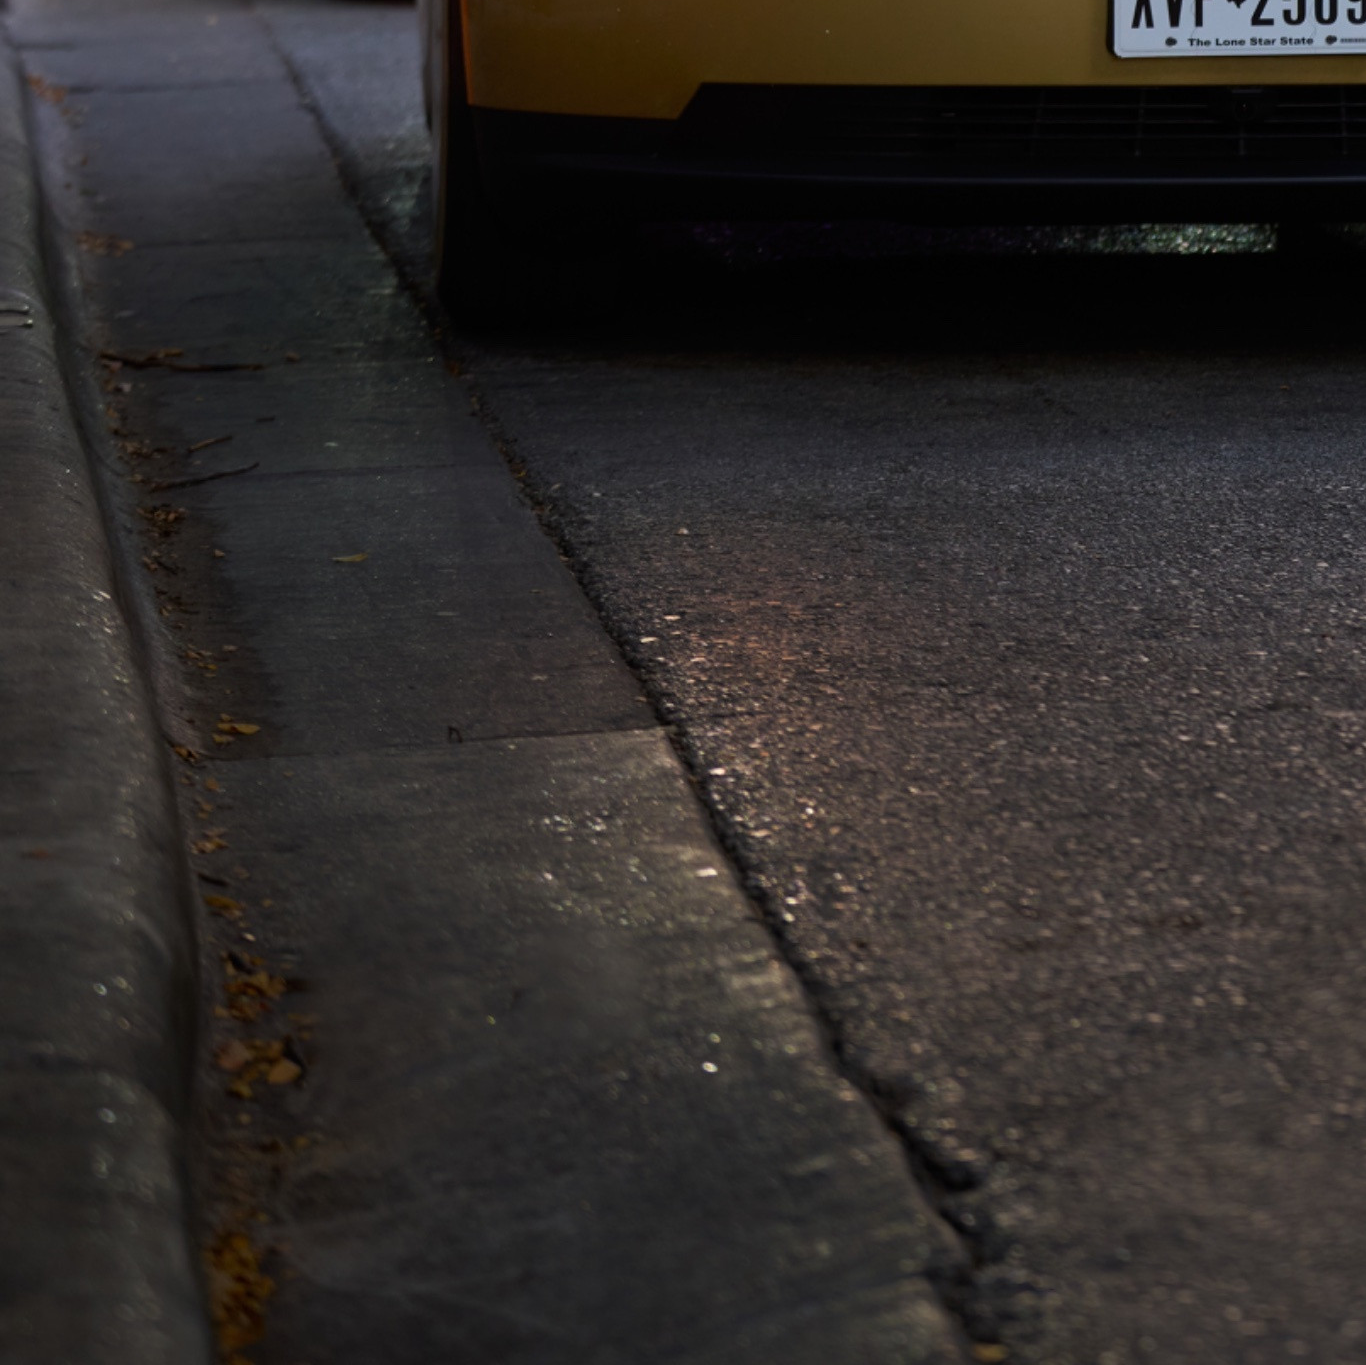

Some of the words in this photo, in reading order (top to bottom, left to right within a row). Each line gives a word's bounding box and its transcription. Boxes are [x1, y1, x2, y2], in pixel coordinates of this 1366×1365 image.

[1188, 37, 1211, 47] The
[1215, 37, 1246, 47] Lone
[1250, 36, 1275, 46] Star
[1279, 36, 1314, 46] State
